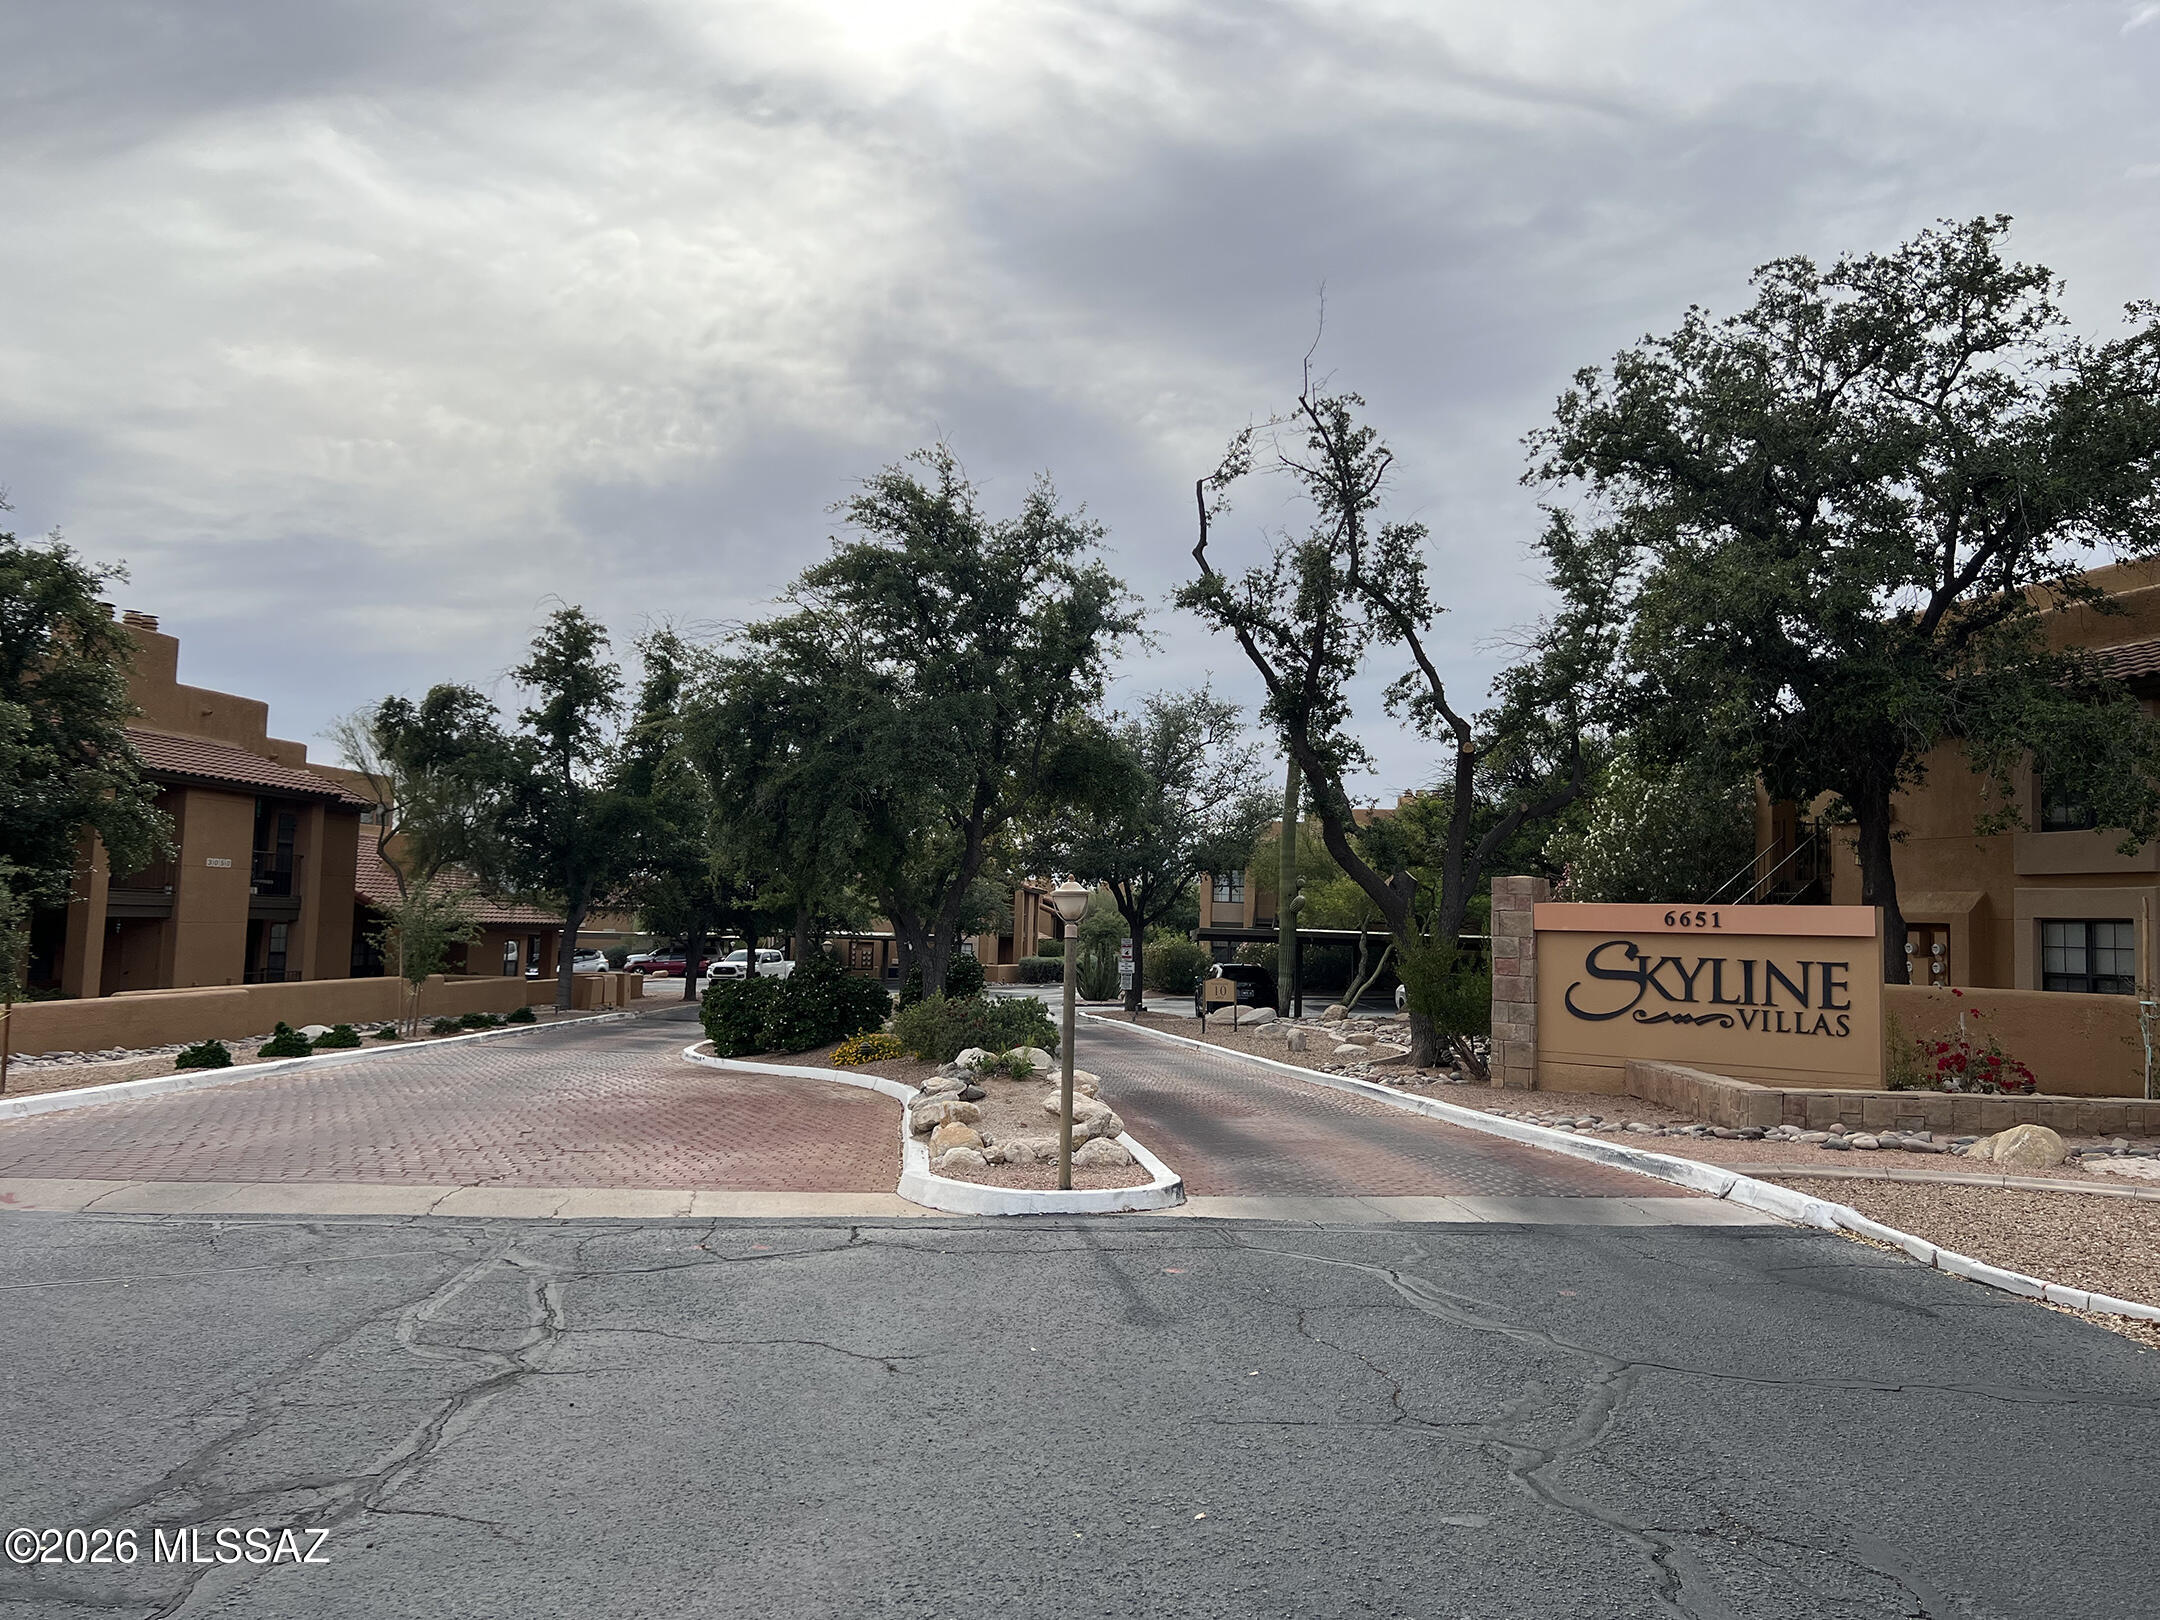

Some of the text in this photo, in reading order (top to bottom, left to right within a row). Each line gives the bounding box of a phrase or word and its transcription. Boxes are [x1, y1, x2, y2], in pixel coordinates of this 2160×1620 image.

[1664, 910, 1722, 928] 6651
[1215, 985, 1227, 996] 10
[1736, 1008, 1850, 1037] VILLAS
